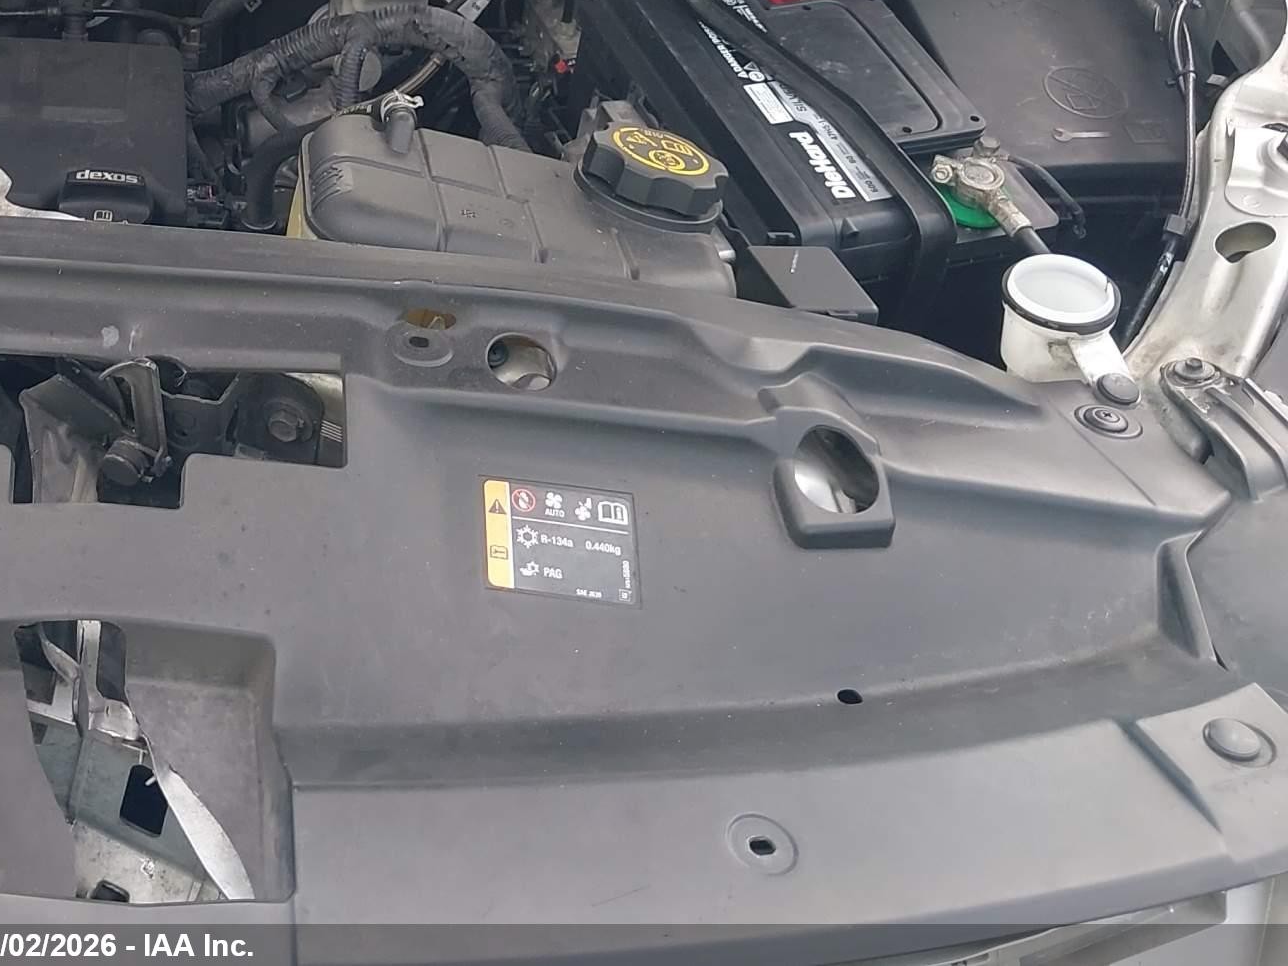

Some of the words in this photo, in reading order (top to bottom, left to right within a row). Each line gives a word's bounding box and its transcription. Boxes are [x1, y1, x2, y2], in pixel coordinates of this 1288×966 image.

[789, 131, 856, 199] DieHard
[75, 169, 138, 184] dexos
[544, 508, 565, 518] AUTO
[540, 534, 574, 548] R-134a
[585, 541, 622, 556] 0.440kg
[543, 566, 563, 579] PAG
